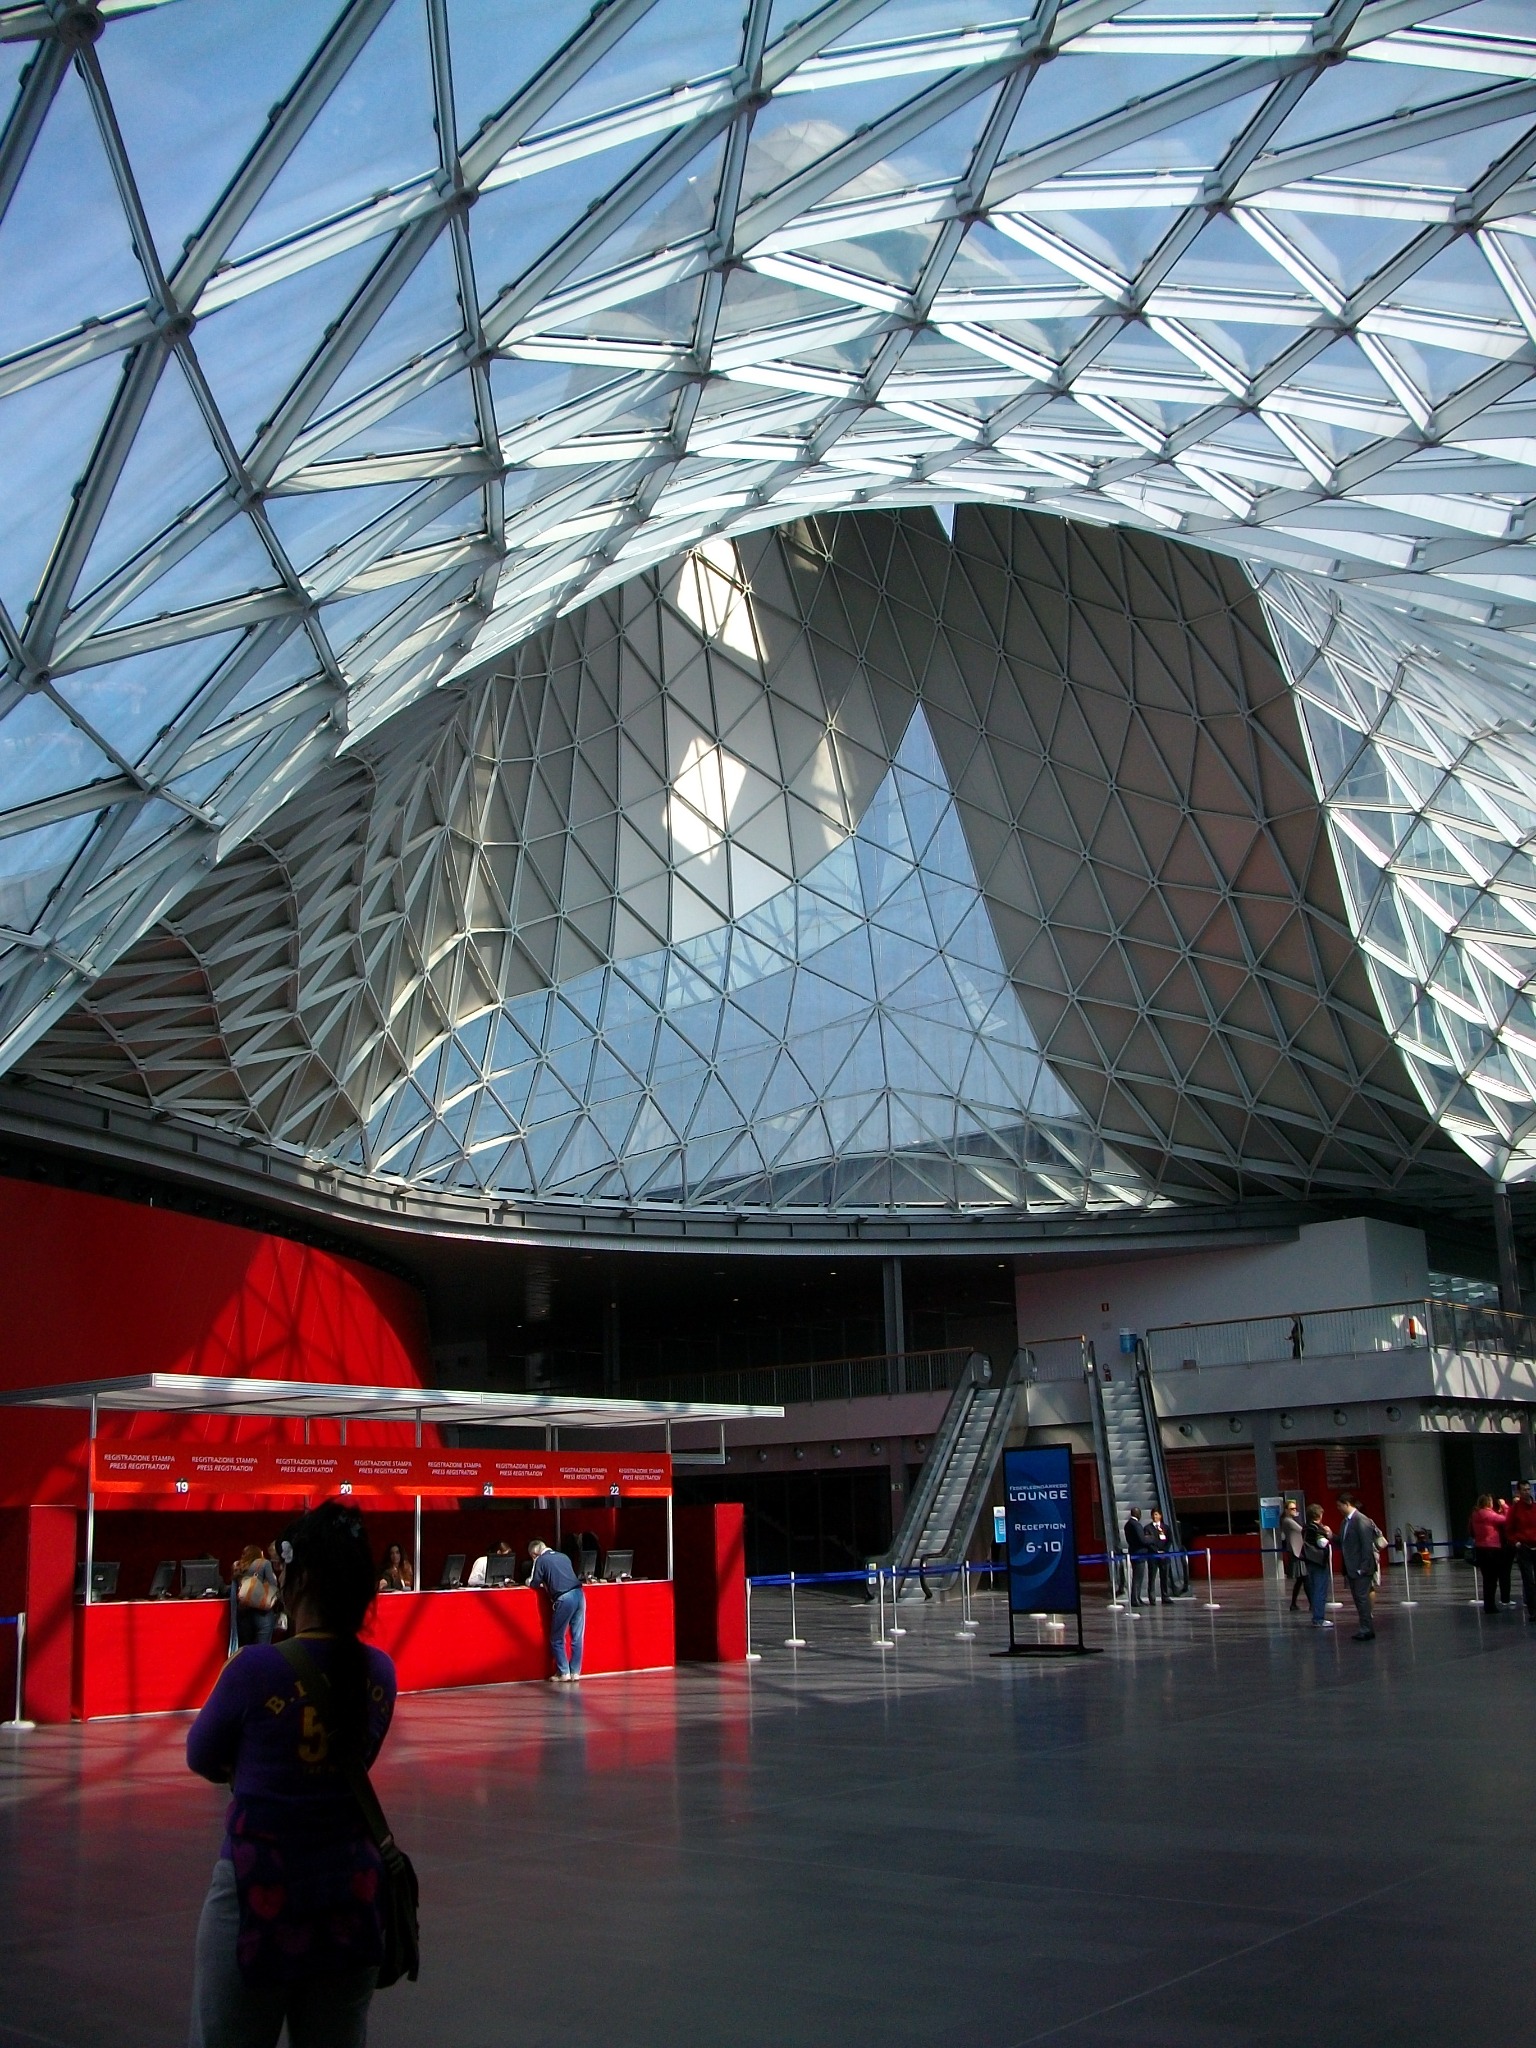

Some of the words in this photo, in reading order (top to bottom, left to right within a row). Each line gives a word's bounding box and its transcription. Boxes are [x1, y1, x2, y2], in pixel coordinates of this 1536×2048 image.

[176, 1482, 188, 1493] 19
[340, 1484, 352, 1494] 20
[483, 1486, 494, 1495] 21
[610, 1486, 619, 1495] 22
[1009, 1490, 1068, 1501] LOUNGE
[1014, 1523, 1066, 1531] RECEPTION
[1026, 1541, 1062, 1553] 6-10
[298, 1706, 328, 1762] 5
